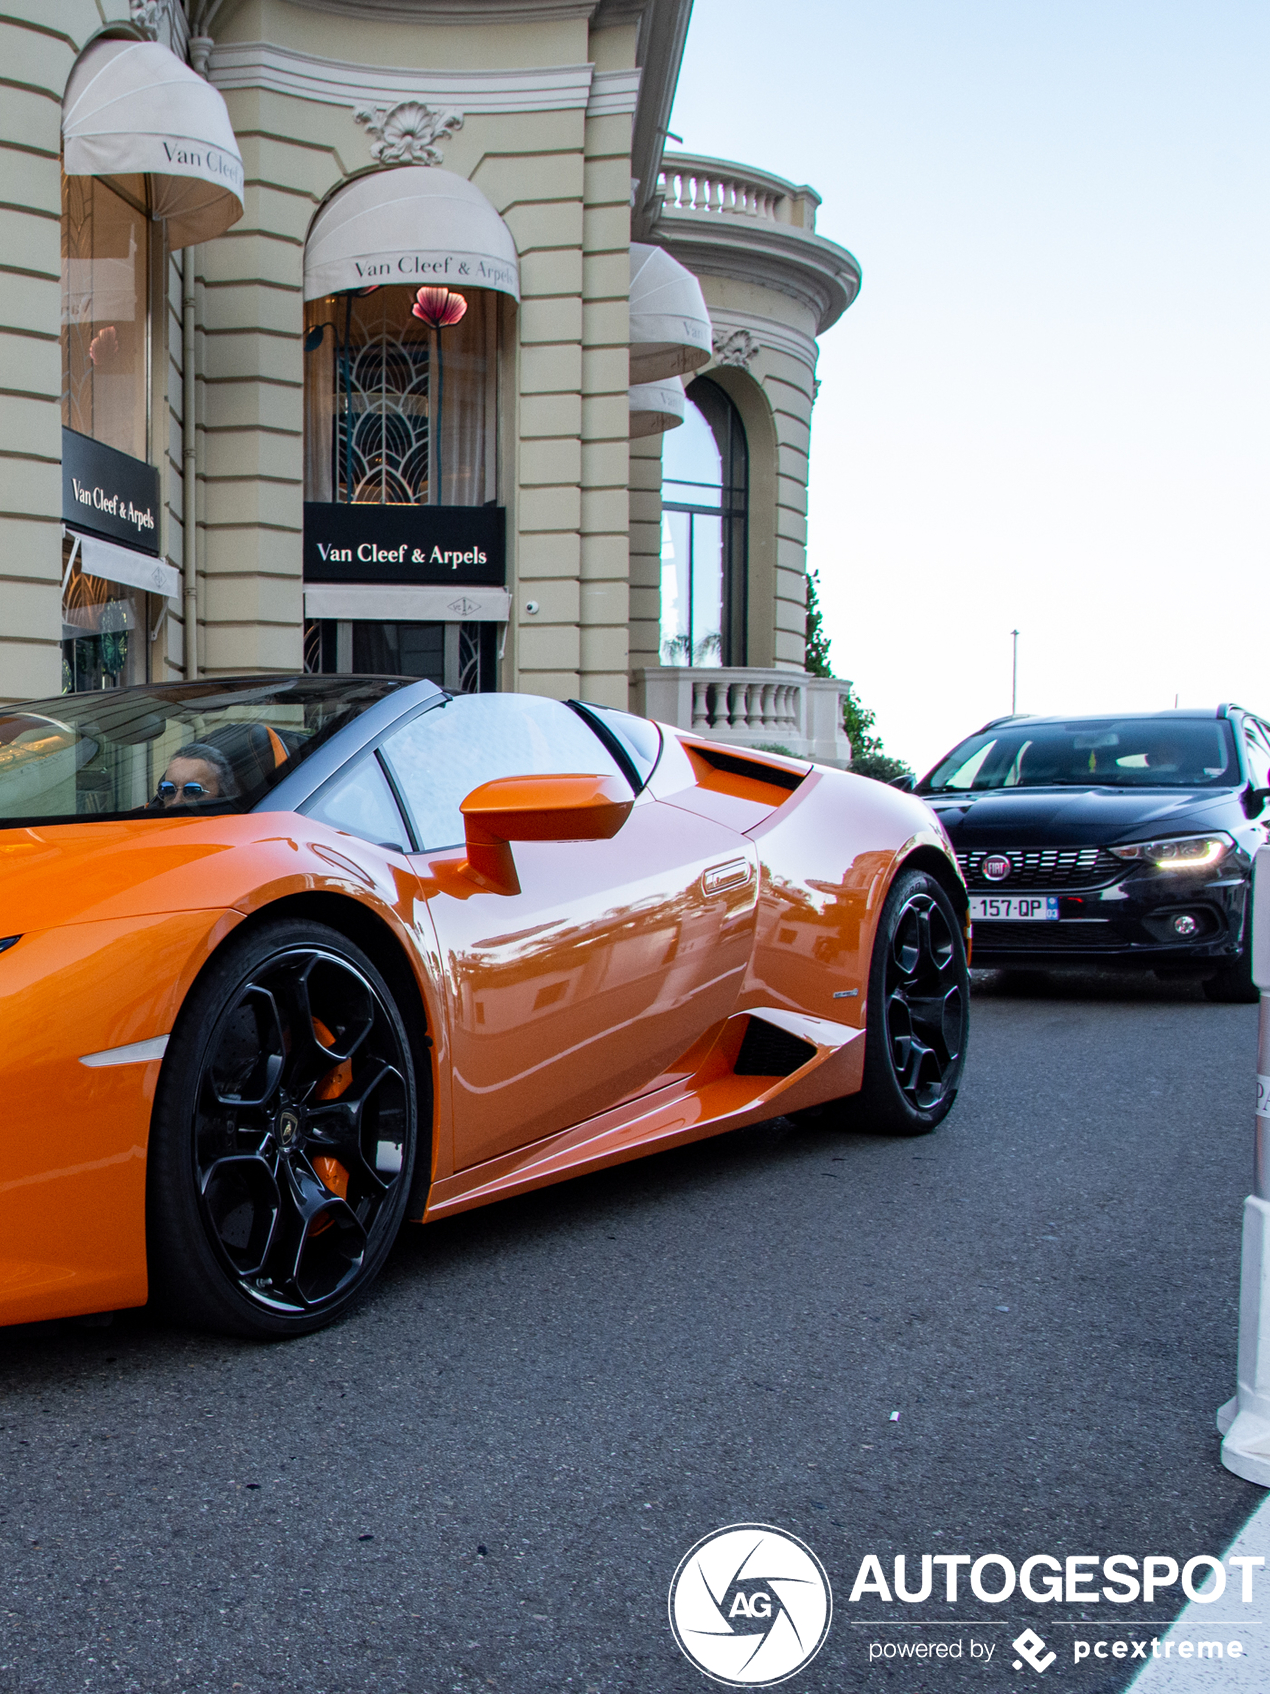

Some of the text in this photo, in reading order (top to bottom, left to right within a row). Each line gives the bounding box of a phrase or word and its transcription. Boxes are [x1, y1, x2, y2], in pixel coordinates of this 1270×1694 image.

[163, 141, 201, 167] Van
[355, 256, 514, 286] Van Cleef & Arpels
[72, 478, 154, 532] Van Cleef & Arpels
[316, 543, 487, 570] Van Cleef & Arpels
[987, 862, 1005, 875] FIAT
[1046, 909, 1058, 918] 03
